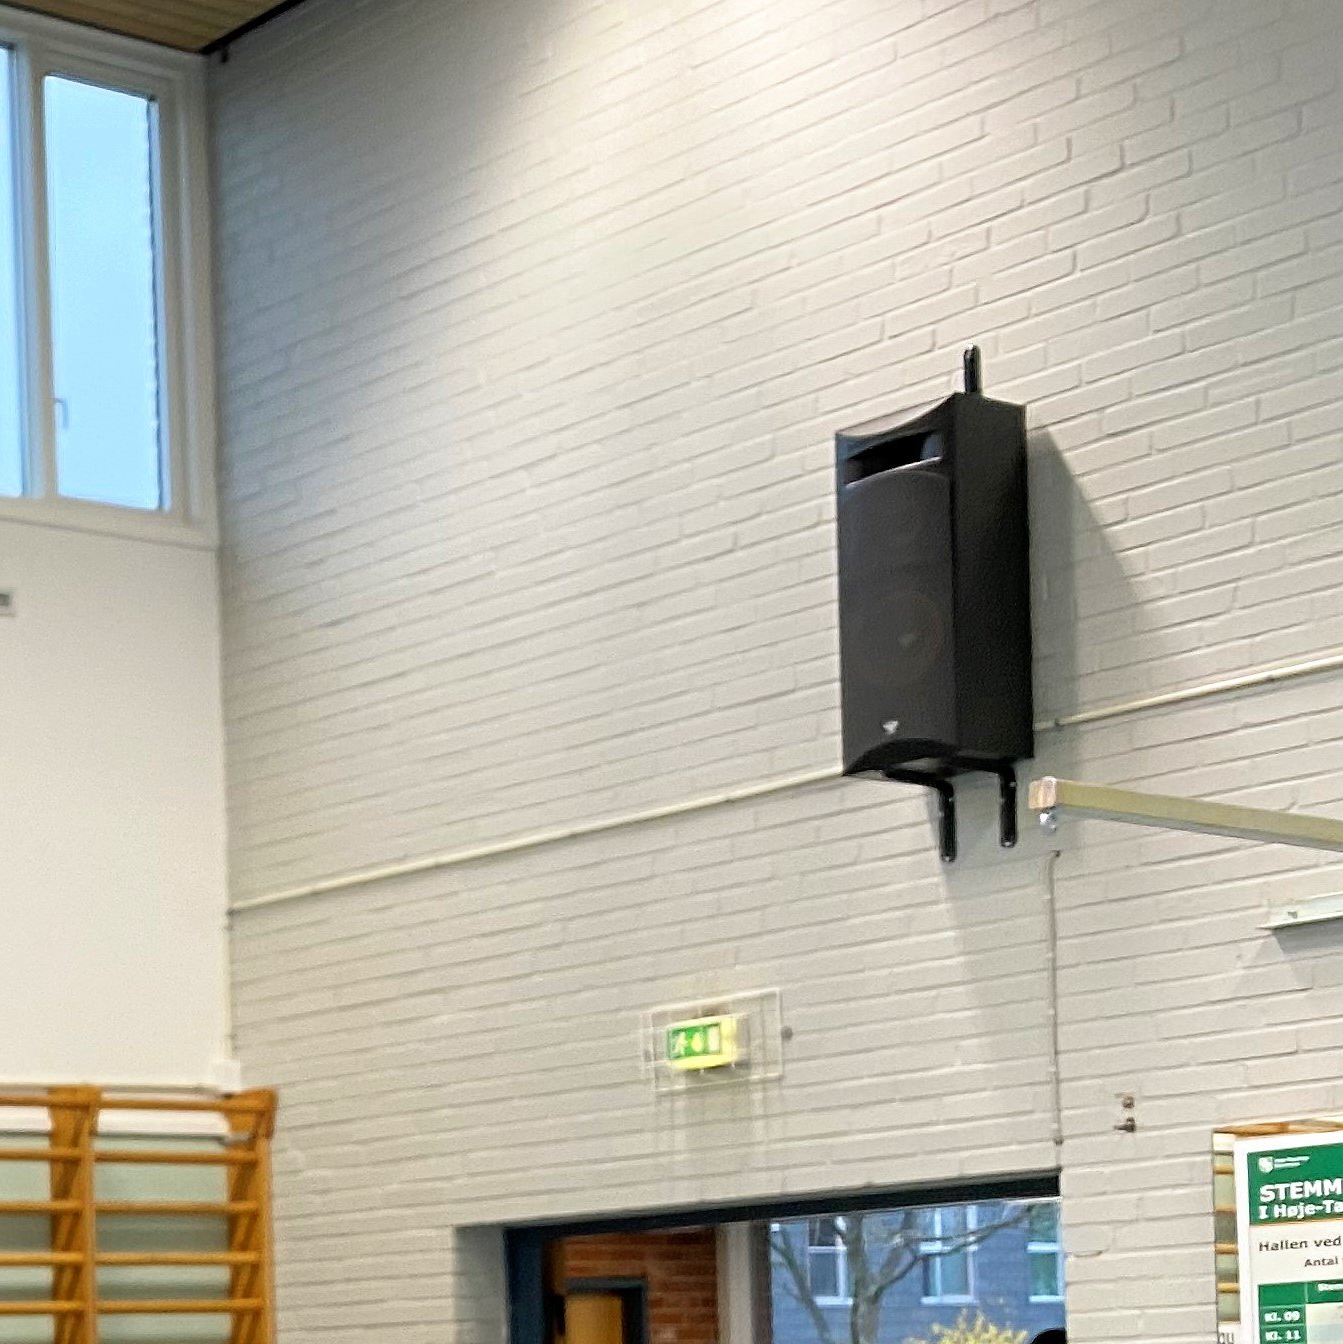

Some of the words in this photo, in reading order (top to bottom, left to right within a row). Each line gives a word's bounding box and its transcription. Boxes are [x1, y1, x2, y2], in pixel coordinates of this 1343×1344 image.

[1258, 1205, 1269, 1220] I
[1258, 1239, 1309, 1252] Hallen
[1313, 1235, 1342, 1248] ved
[1303, 1255, 1339, 1268] Antal
[1285, 1329, 1301, 1341] 11
